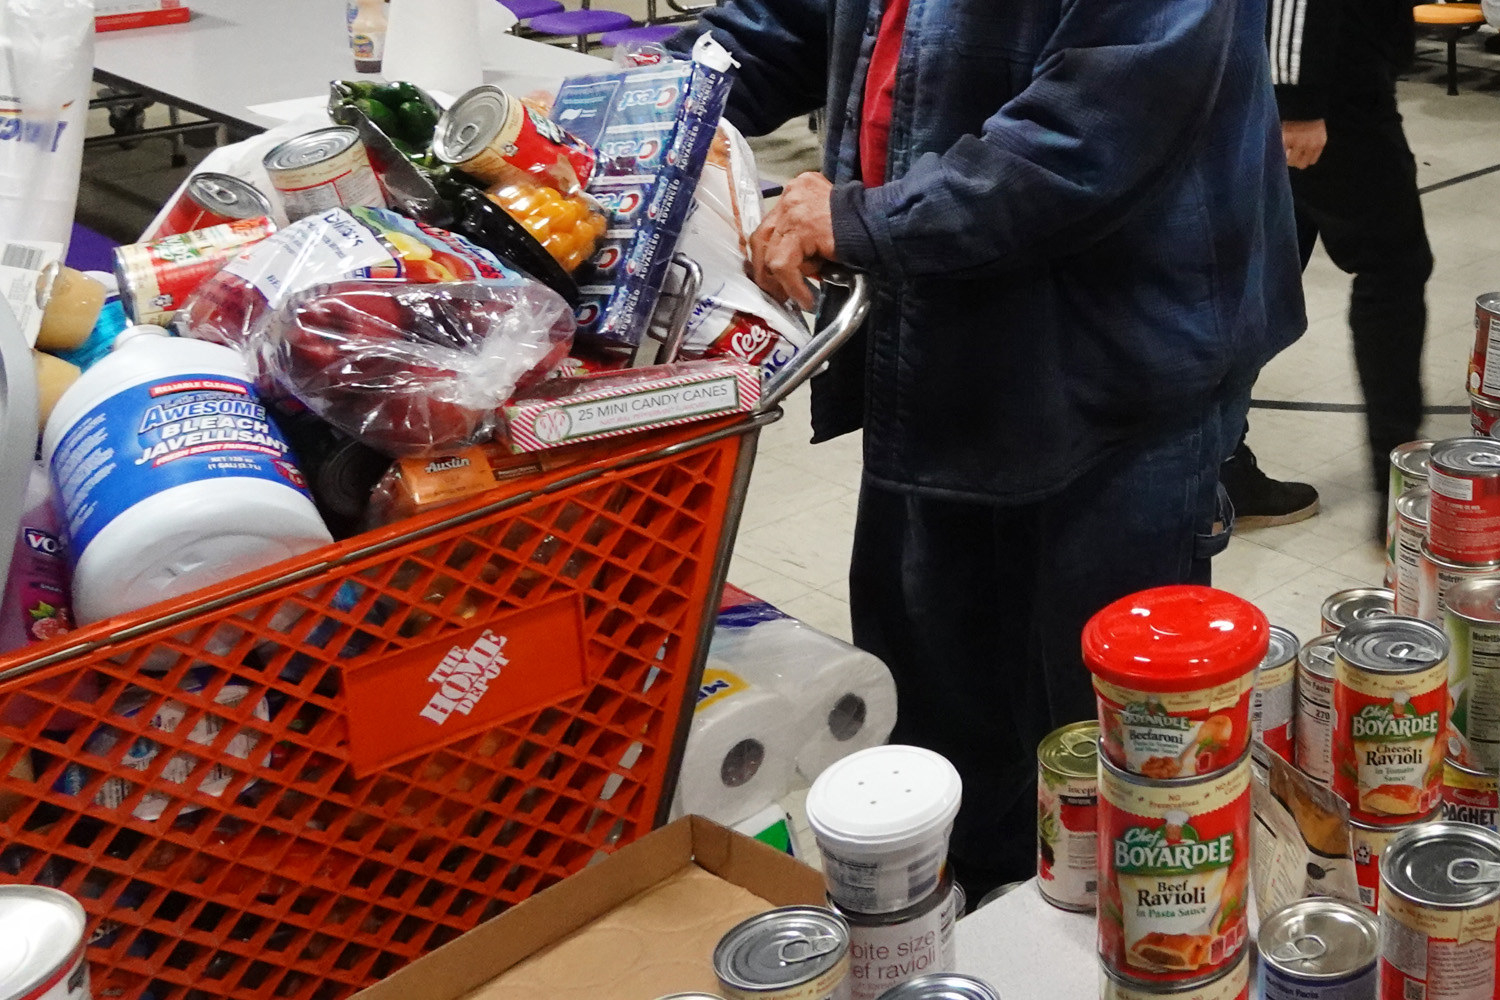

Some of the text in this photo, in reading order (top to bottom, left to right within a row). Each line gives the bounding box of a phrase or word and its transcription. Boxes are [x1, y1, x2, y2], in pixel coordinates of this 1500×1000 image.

[578, 384, 728, 422] 25 MINI CANDY CANES
[138, 400, 267, 434] AWESOME
[161, 416, 270, 440] BLEACH
[134, 429, 290, 466] JAVELLISANT
[424, 456, 471, 475] Austin
[428, 645, 469, 683] THE
[419, 629, 508, 726] HOME
[454, 652, 510, 716] DEPOT
[1352, 712, 1439, 736] BOYARDEE
[1361, 705, 1391, 722] Chef
[1130, 730, 1184, 744] Beefaroni
[1375, 743, 1412, 755] Cheese
[1365, 751, 1423, 767] Ravioli
[1125, 826, 1160, 845] Chef
[1114, 834, 1233, 869] BOYARDEE
[1137, 886, 1207, 907] Ravioli
[1157, 880, 1189, 893] Beef
[1137, 905, 1207, 918] in Pasta Sauce
[897, 929, 936, 957] size
[878, 949, 937, 980] ravioli
